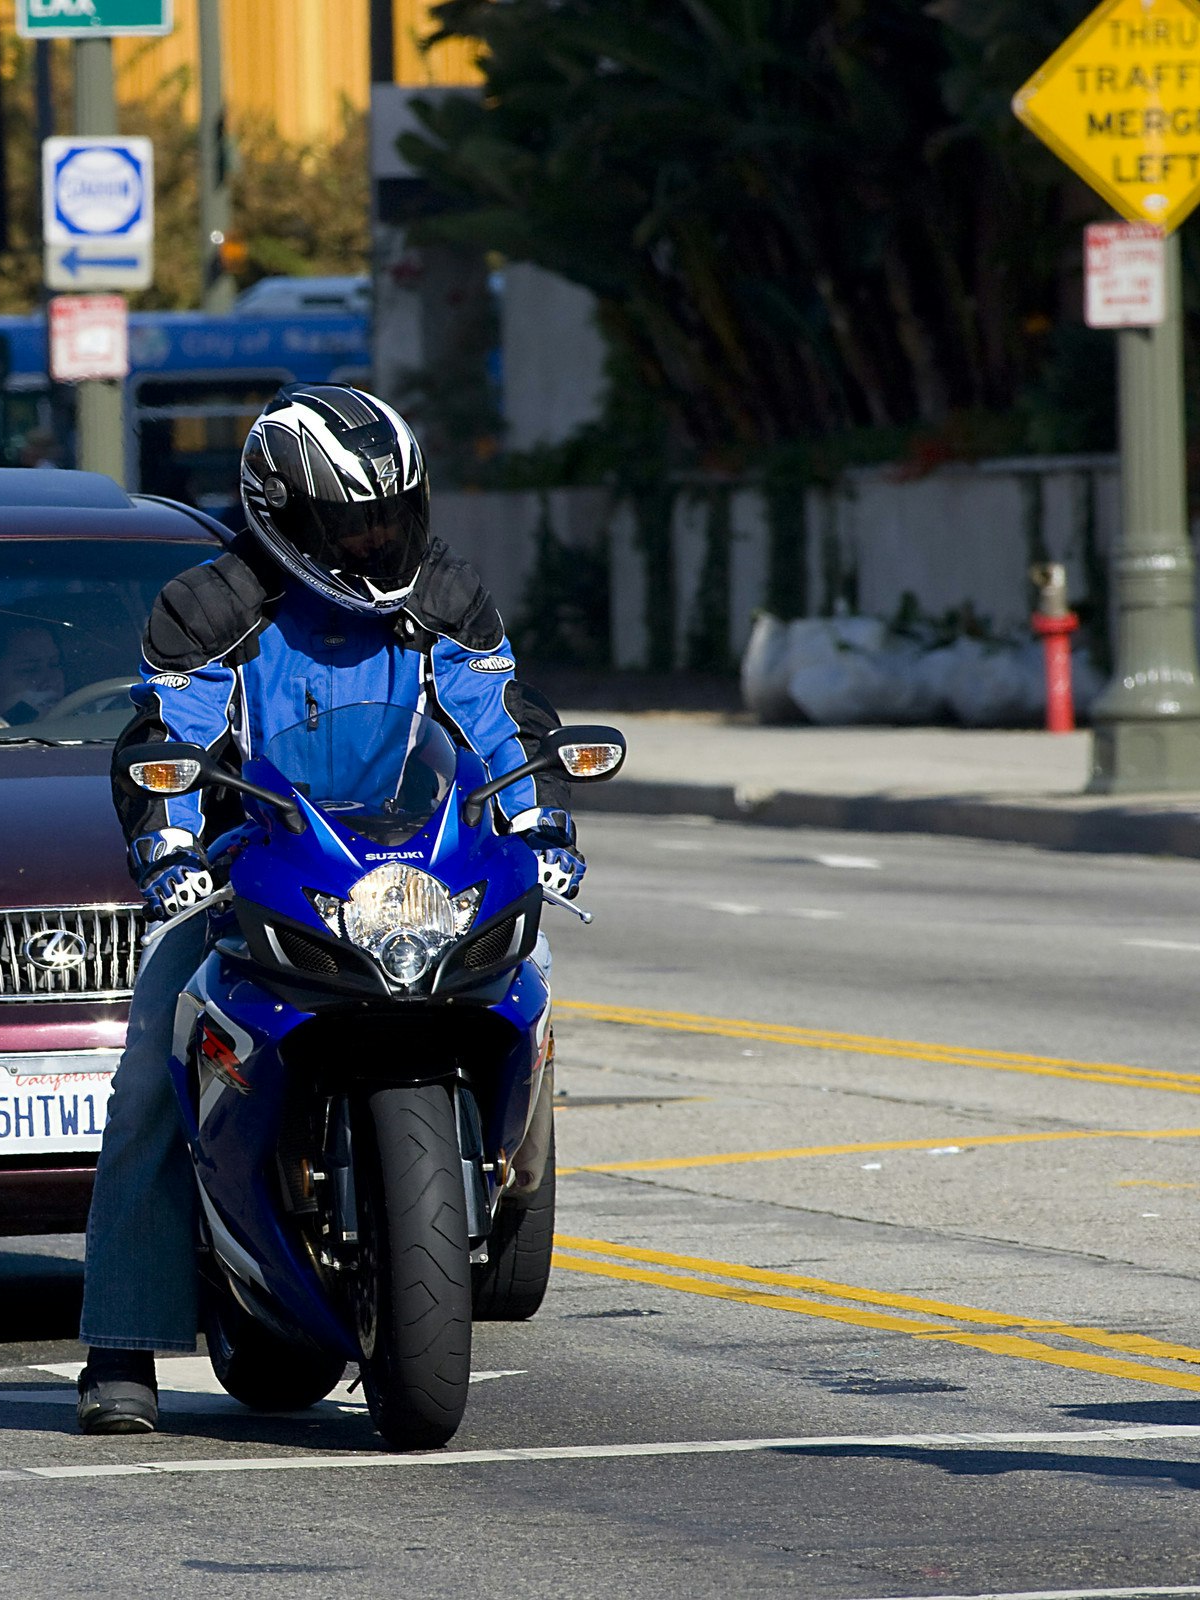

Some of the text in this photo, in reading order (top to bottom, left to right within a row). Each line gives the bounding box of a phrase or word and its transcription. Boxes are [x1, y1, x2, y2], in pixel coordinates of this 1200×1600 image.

[1110, 19, 1199, 48] THRU
[1086, 106, 1200, 139] MERG
[1112, 152, 1200, 184] LEFT
[365, 850, 425, 861] SUZUKI
